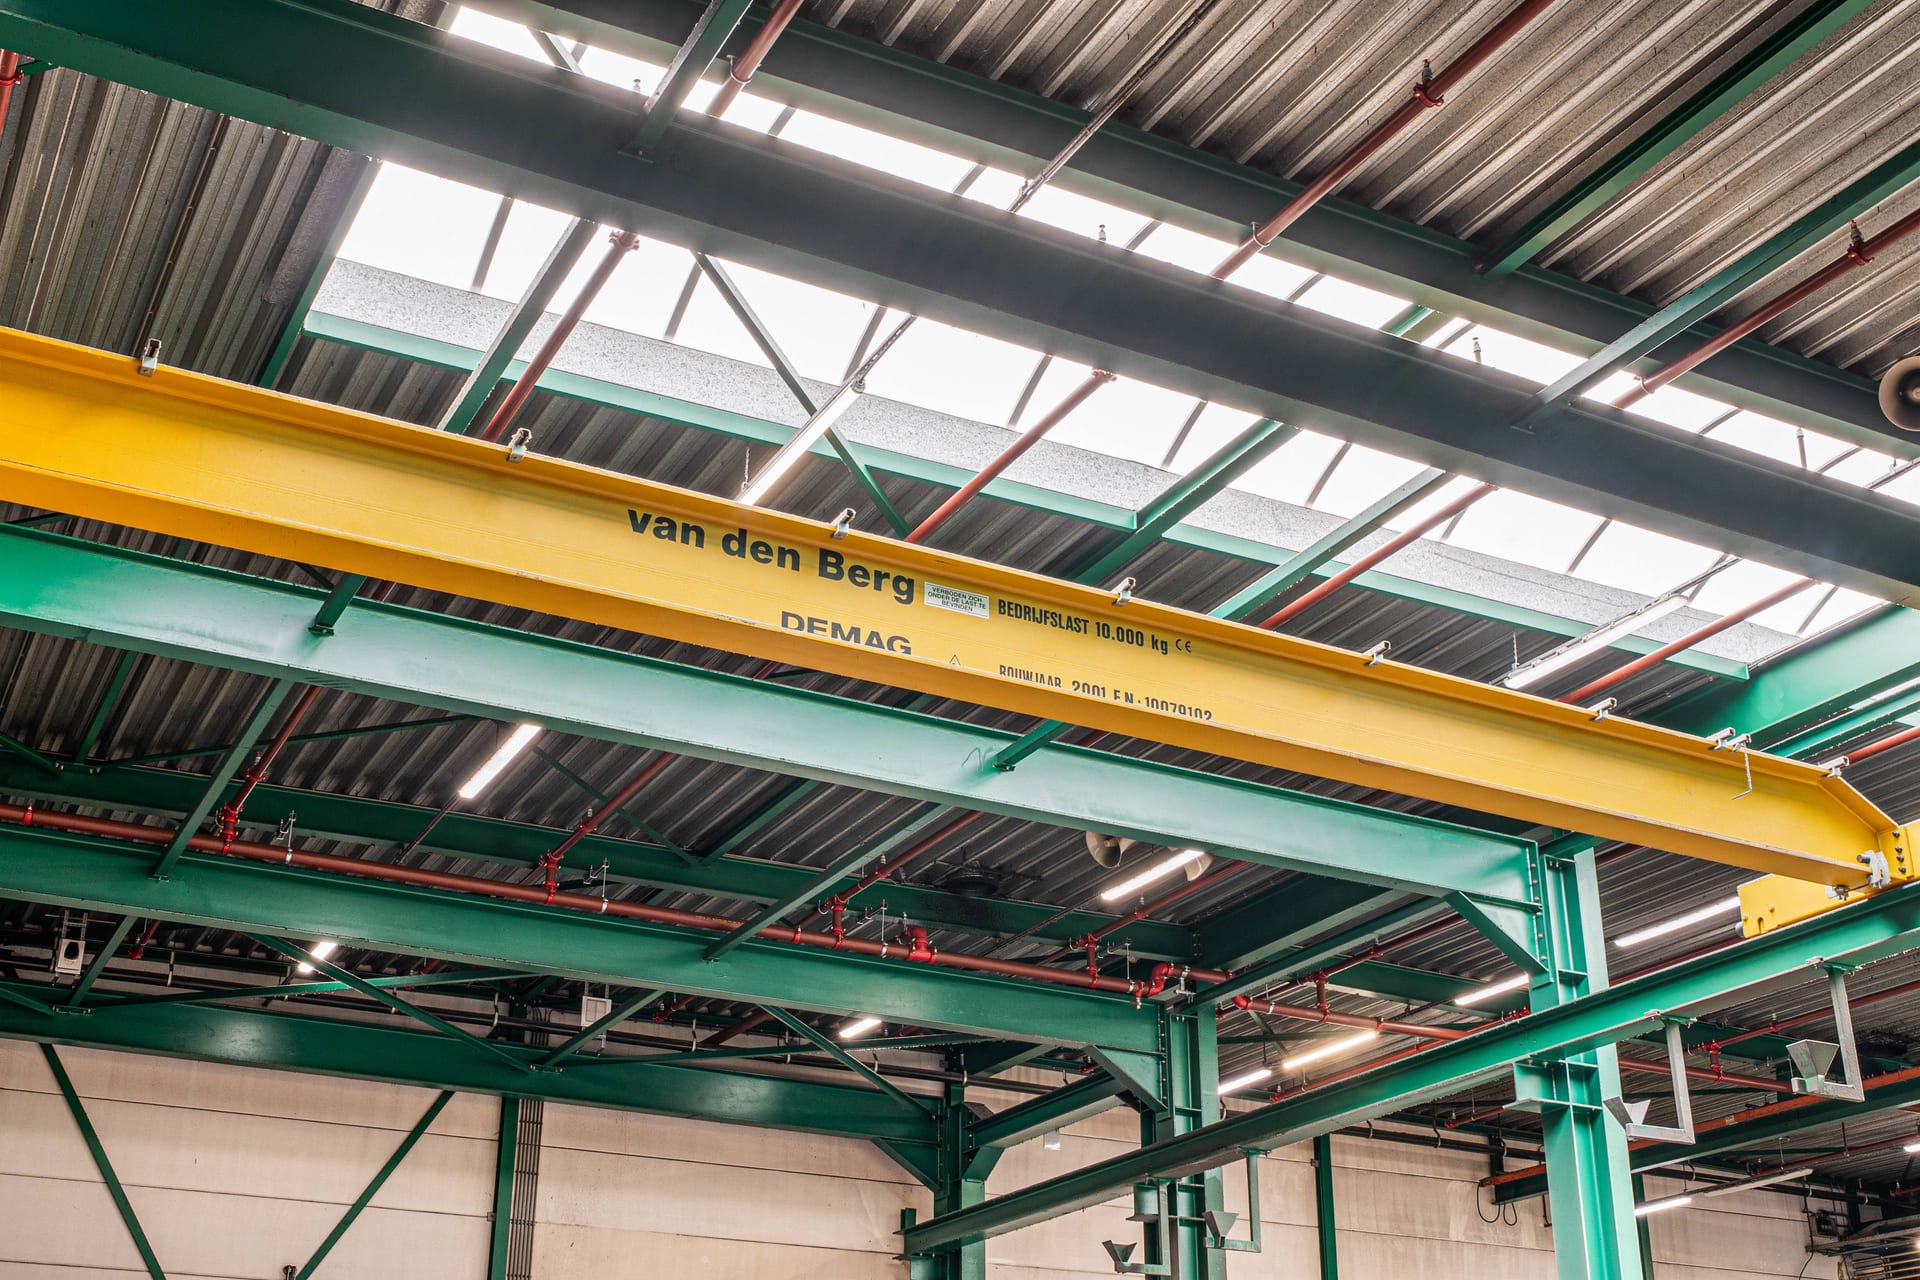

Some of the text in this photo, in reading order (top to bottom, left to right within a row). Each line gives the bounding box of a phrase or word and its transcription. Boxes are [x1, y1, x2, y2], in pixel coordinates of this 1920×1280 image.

[628, 509, 915, 605] van den Berg
[927, 591, 950, 601] ONDER
[961, 599, 977, 607] LAST
[931, 586, 983, 603] VERBODEN ZICH
[941, 600, 973, 611] BEVINDEN
[781, 610, 912, 656] DEMAG
[998, 599, 1089, 634] BEDRIJFSLAST
[1095, 621, 1144, 647] 10.000
[1151, 634, 1168, 655] kg
